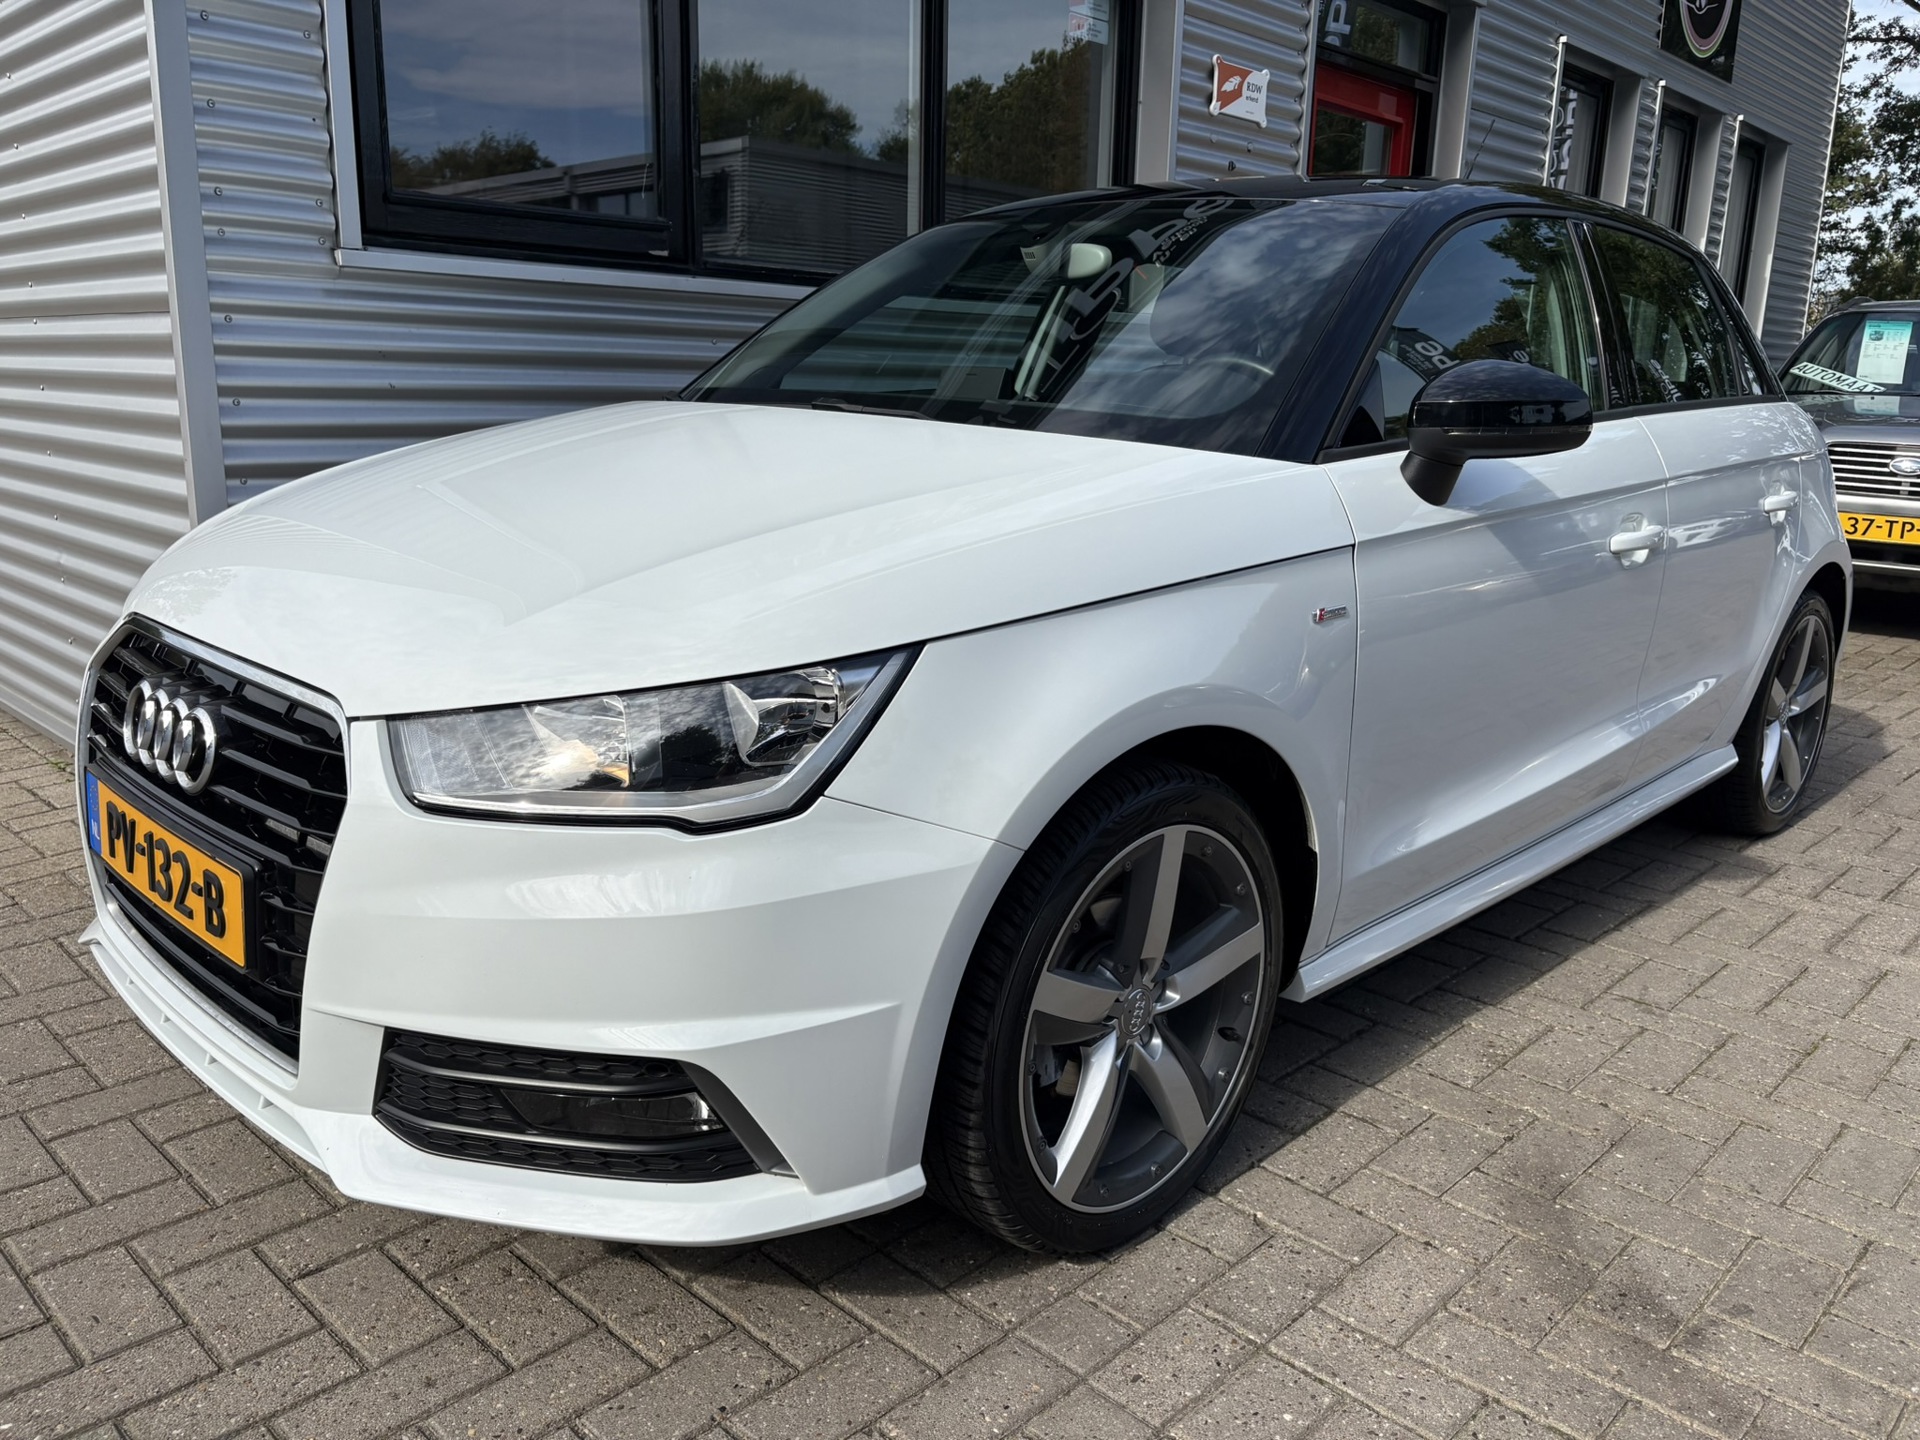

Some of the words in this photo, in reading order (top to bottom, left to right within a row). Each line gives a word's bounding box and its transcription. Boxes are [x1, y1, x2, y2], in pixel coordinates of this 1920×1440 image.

[1246, 81, 1263, 94] RDW
[1791, 363, 1881, 392] AUTOMAAT
[106, 800, 227, 939] PV-132-B
